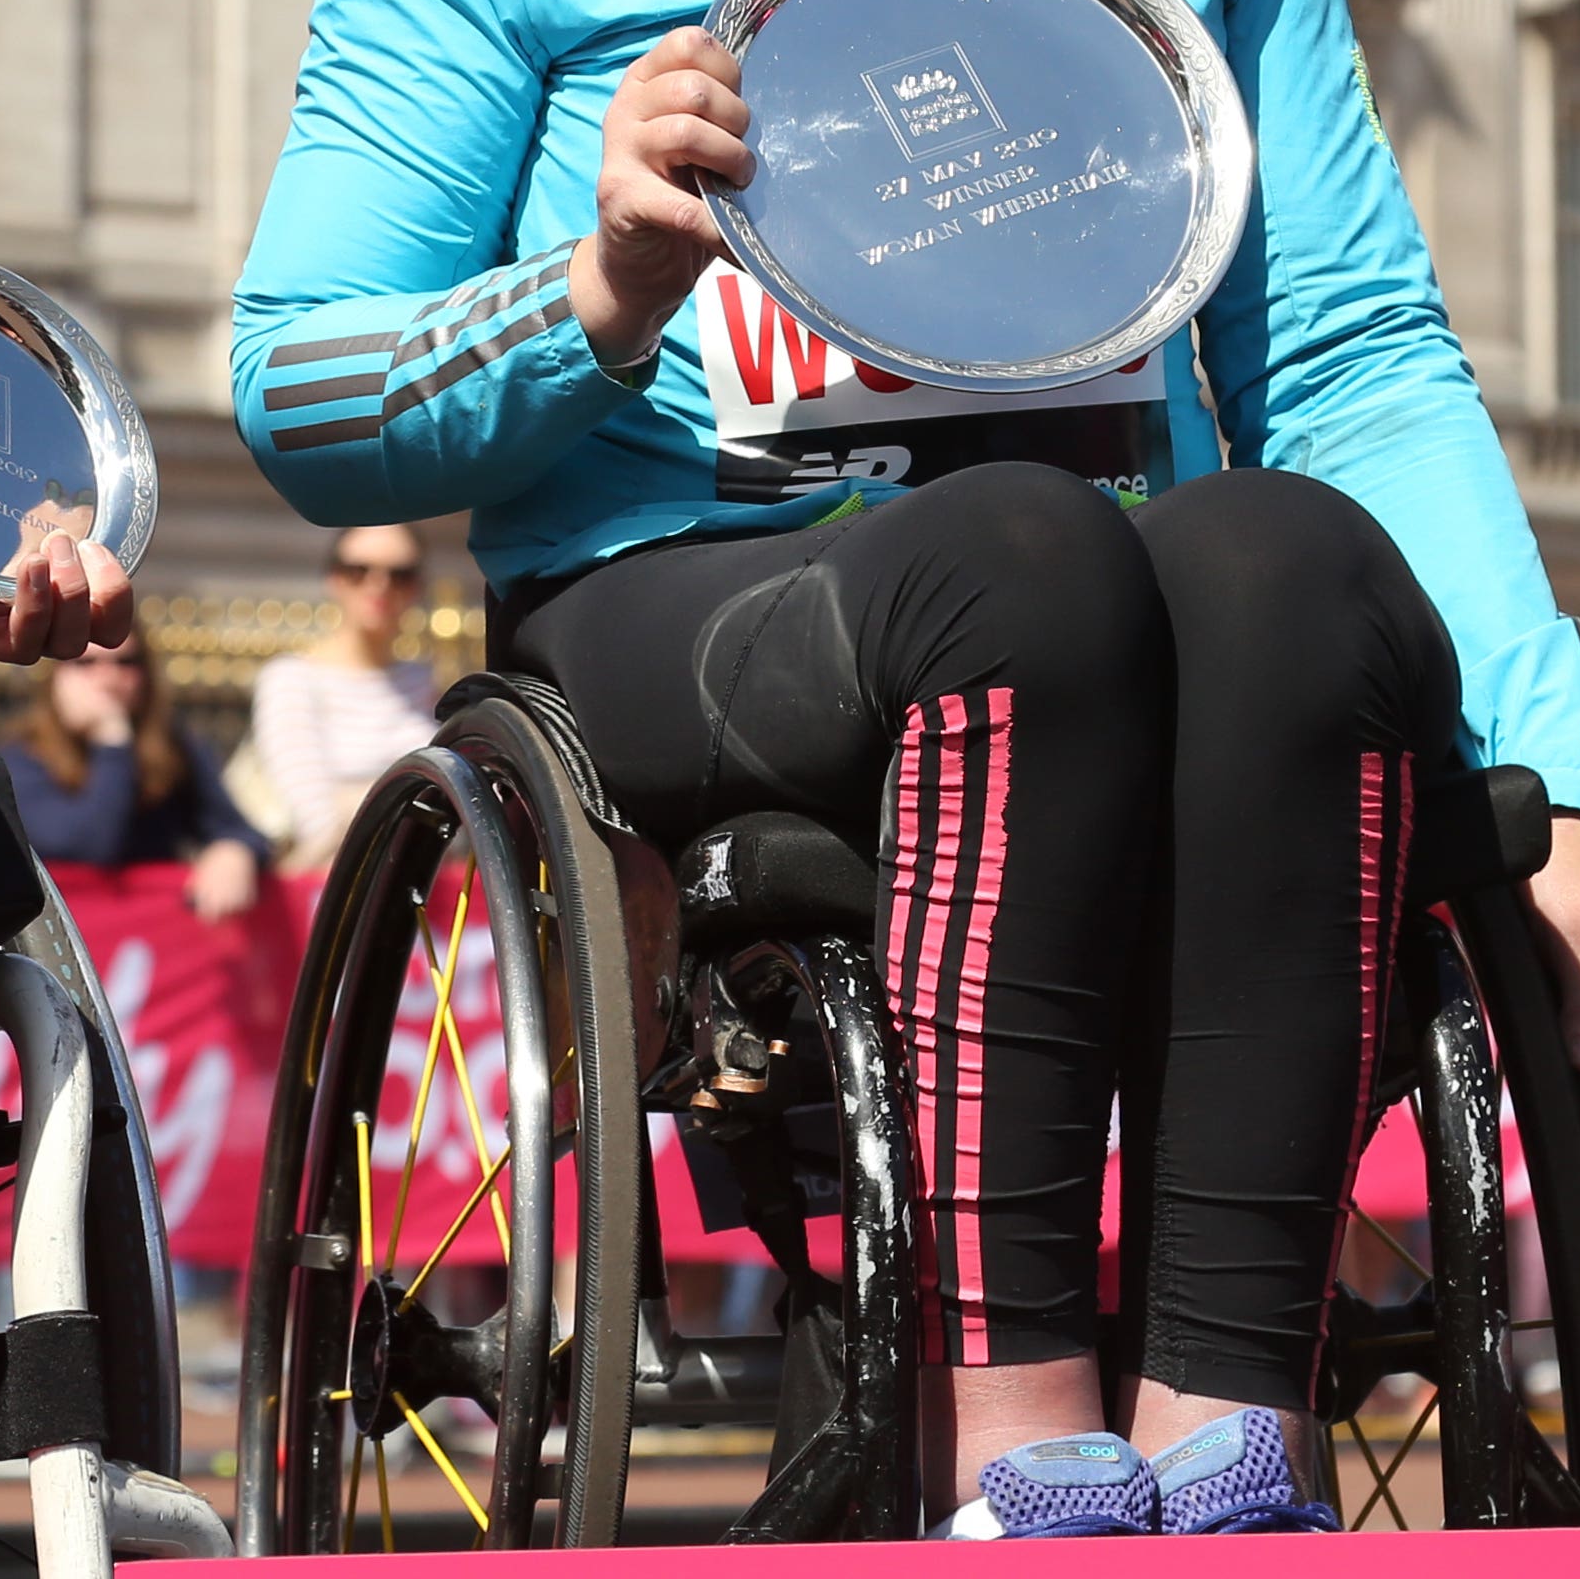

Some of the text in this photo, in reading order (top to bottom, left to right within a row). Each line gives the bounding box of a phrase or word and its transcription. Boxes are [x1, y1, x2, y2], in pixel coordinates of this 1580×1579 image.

[875, 127, 1059, 202] 27 MAY 2019
[923, 164, 1039, 211] WINNER
[856, 158, 1132, 265] WOMAN WHEELCHAIR
